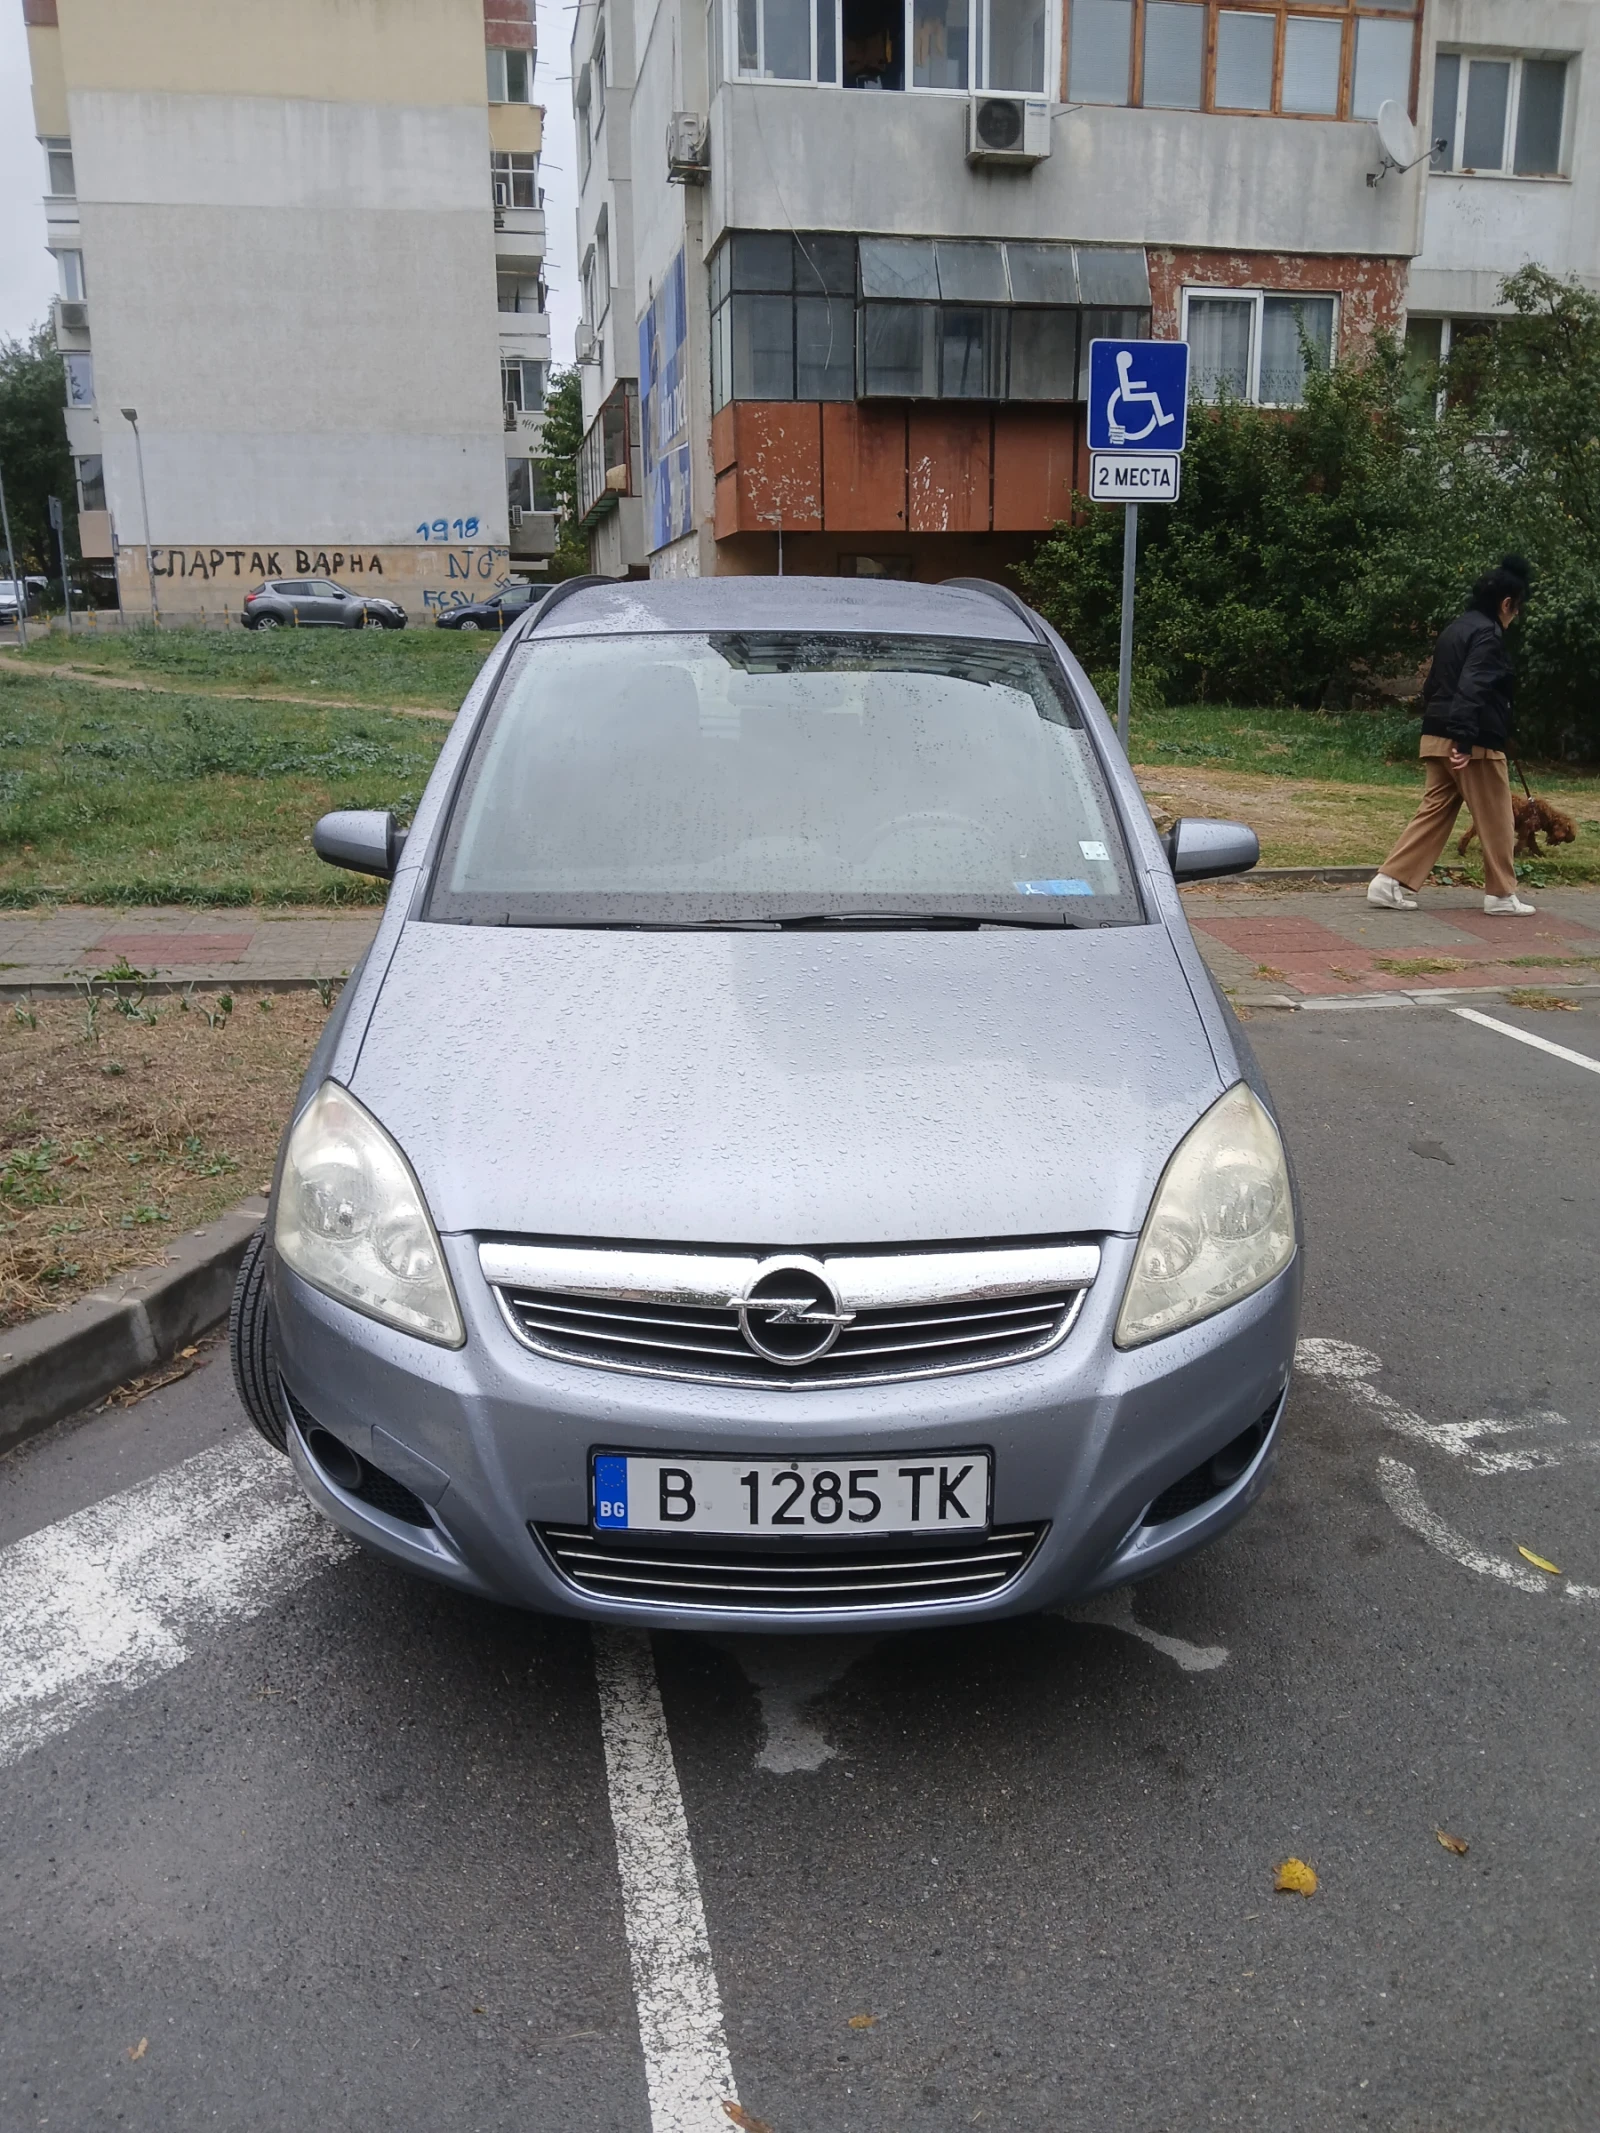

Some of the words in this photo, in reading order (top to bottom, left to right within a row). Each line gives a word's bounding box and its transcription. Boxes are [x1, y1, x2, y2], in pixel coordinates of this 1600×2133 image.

[1099, 467, 1109, 486] 2
[1115, 468, 1171, 487] МЕСТА
[416, 516, 479, 541] 1918
[150, 548, 282, 579] СПАРТАК
[295, 549, 383, 577] ВАРНА
[659, 1467, 696, 1522] B
[740, 1470, 882, 1525] 1285
[898, 1464, 974, 1522] TK
[600, 1500, 625, 1517] BG
